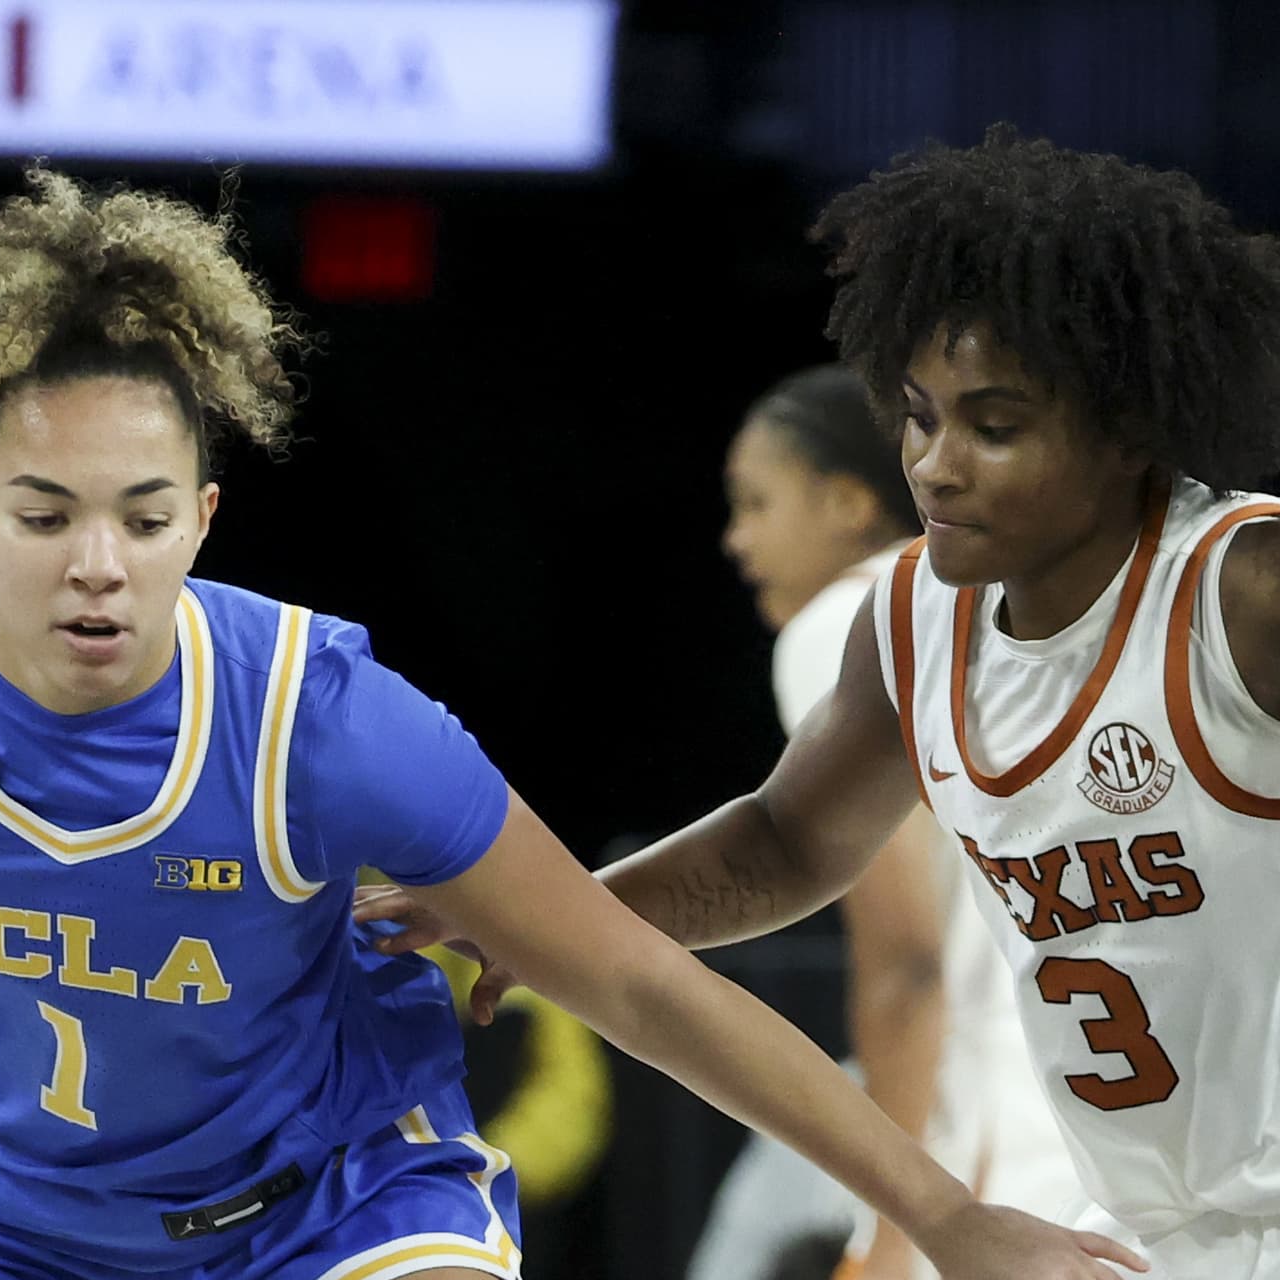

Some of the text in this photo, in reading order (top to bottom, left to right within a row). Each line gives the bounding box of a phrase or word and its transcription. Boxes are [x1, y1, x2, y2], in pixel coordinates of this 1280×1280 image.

[1090, 725, 1154, 792] SEC
[1092, 779, 1167, 815] GRADUATE
[36, 1000, 99, 1132] 1
[1034, 956, 1180, 1112] 3
